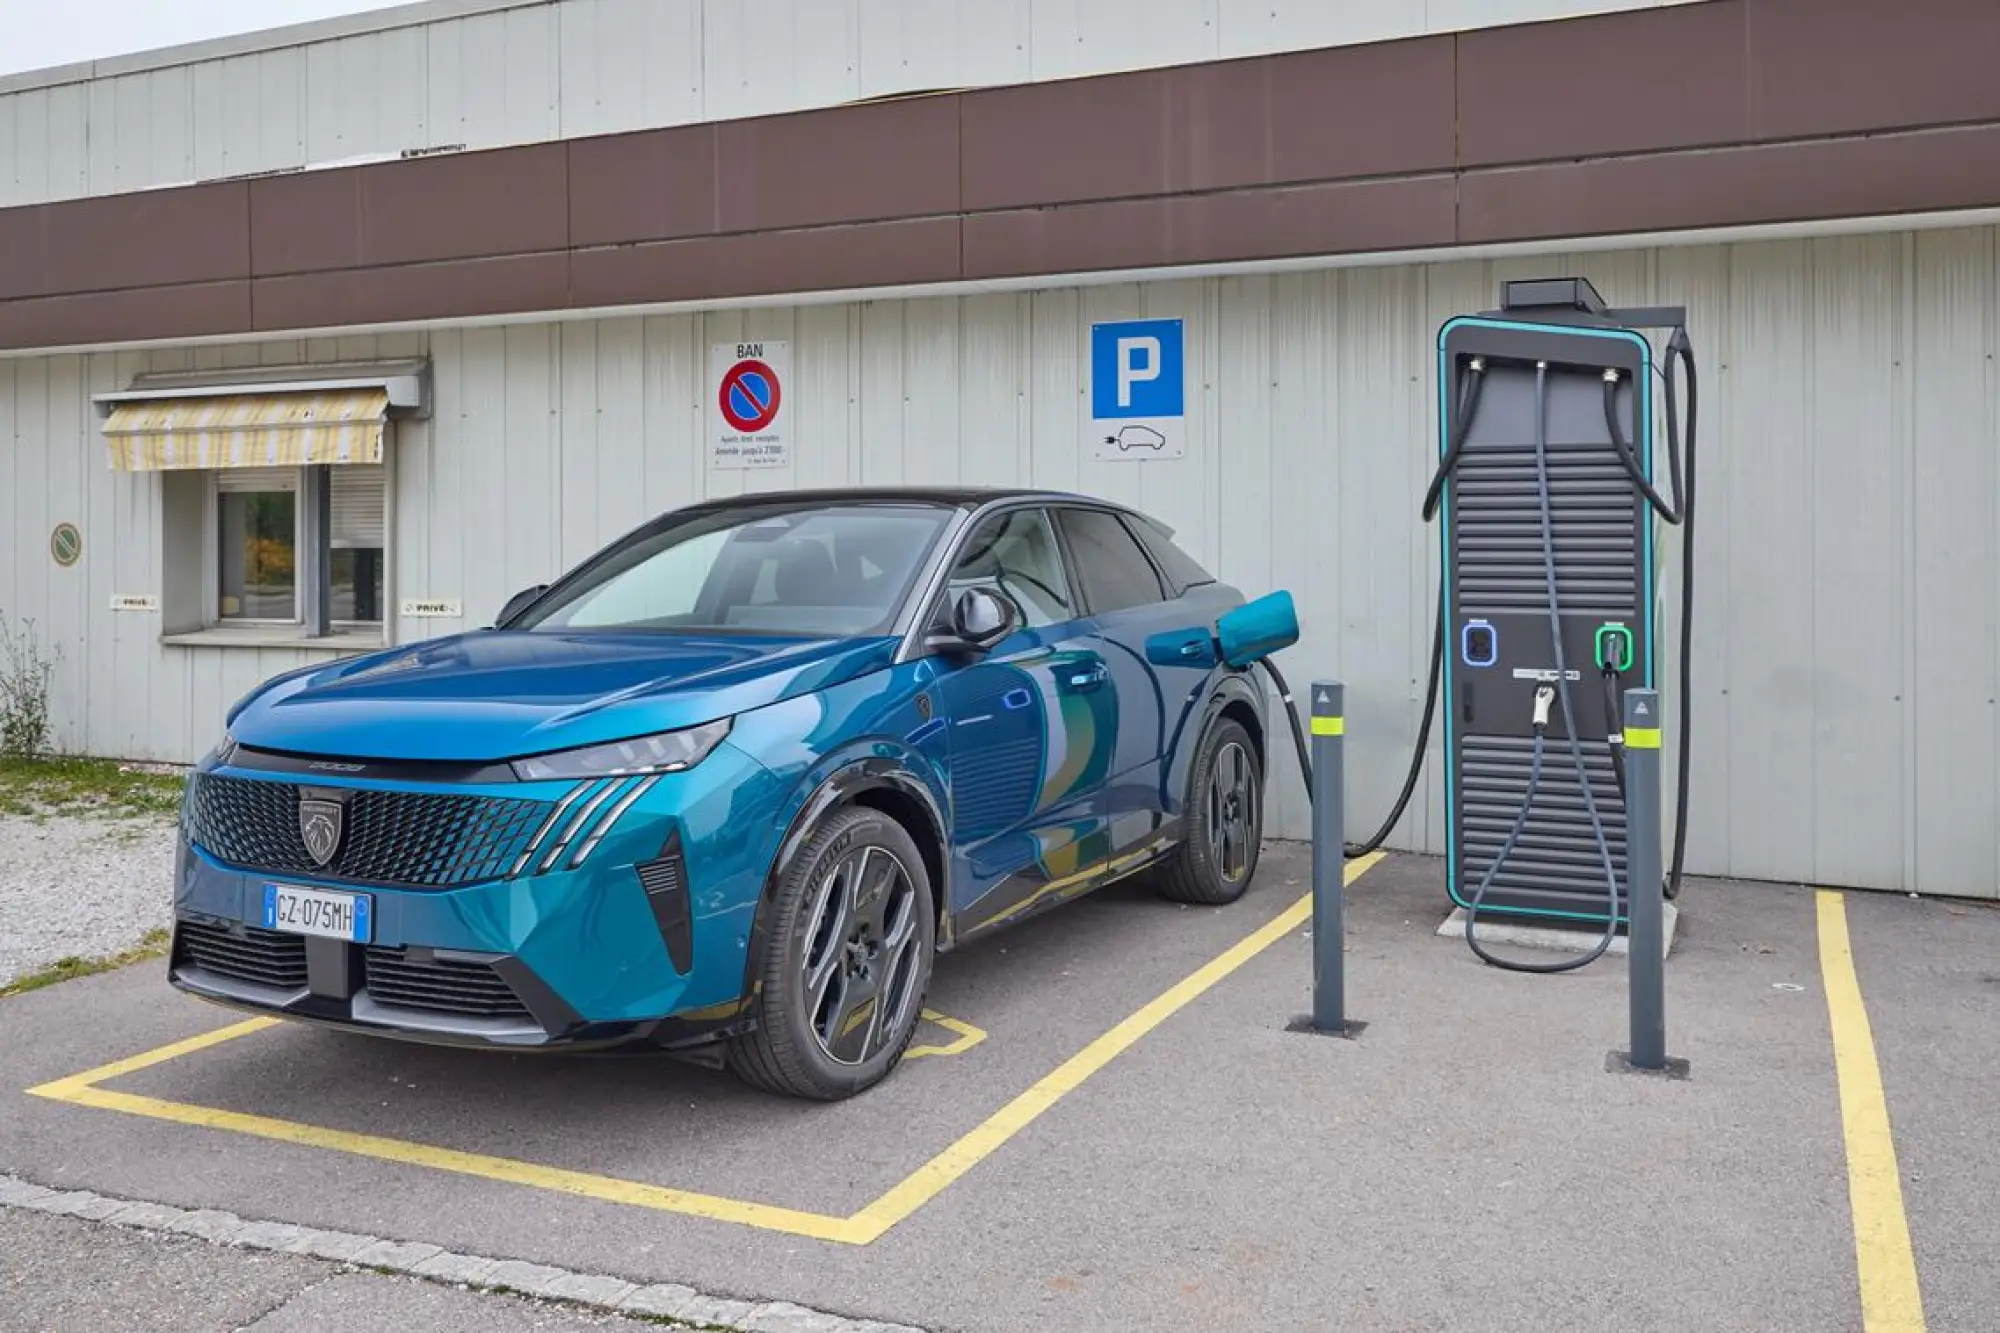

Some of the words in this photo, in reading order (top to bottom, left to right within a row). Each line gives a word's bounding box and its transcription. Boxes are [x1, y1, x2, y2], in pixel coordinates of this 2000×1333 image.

[737, 344, 764, 358] BAN
[1117, 336, 1160, 407] P
[278, 894, 297, 923] GZ
[303, 898, 353, 932] 075MH
